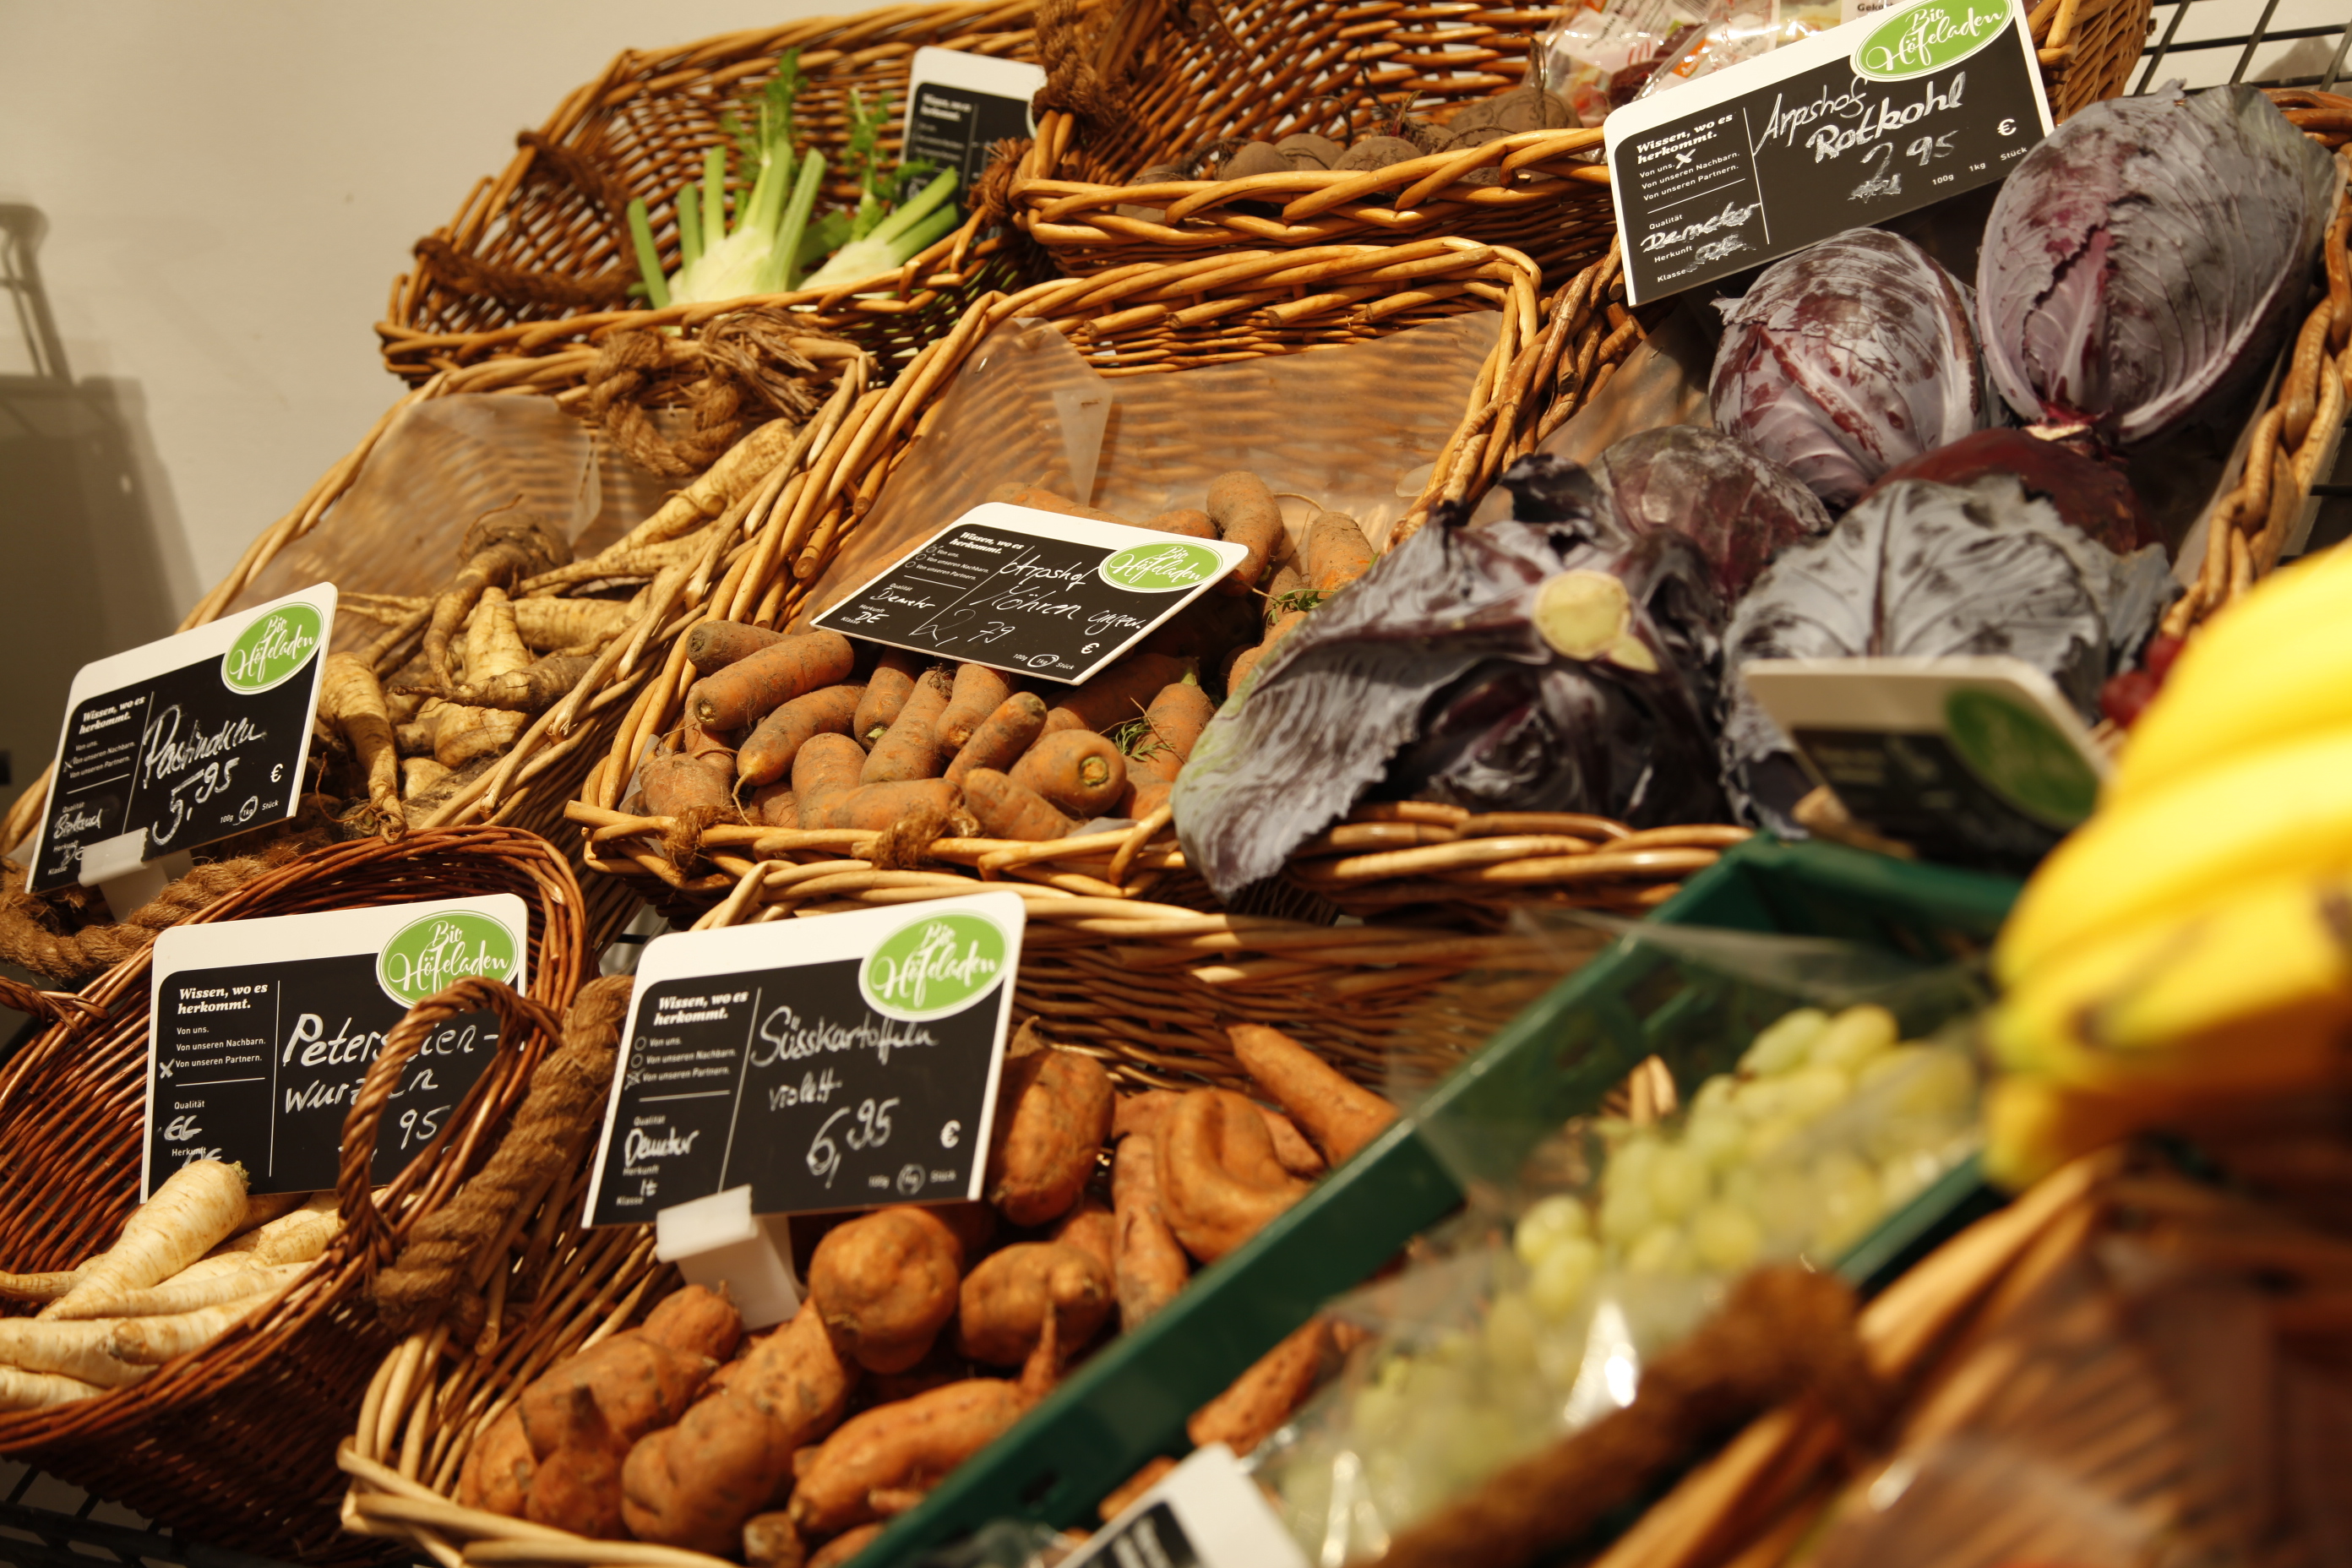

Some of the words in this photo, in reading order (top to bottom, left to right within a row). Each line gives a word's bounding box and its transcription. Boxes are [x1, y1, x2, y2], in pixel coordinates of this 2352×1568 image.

[1904, 8, 1945, 35] Bio
[1866, 7, 2003, 71] Höfeladen
[1805, 71, 1965, 163] Rotkohl
[1636, 131, 1690, 154] Wissen,
[1694, 121, 1715, 133] wo
[1718, 114, 1733, 124] es
[1997, 118, 2017, 136] €
[1637, 131, 1718, 164] herkommt.
[1639, 170, 1655, 178] Von
[1657, 163, 1675, 172] uns.
[1642, 181, 1657, 189] Von
[1659, 169, 1693, 183] unseren
[1696, 152, 1740, 171] Nachbarn.
[1932, 174, 1954, 185] 100g
[1969, 162, 1986, 172] 1kg
[2001, 147, 2028, 161] Stück
[1643, 192, 1659, 201] Von
[1661, 180, 1696, 195] unseren
[1698, 165, 1739, 182] Partnern.
[1649, 214, 1683, 230] Qualität
[1654, 245, 1692, 263] Herkunft
[1657, 269, 1686, 282] Klasse
[949, 538, 1003, 554] herkommt.
[960, 531, 994, 545] Wissen,
[1159, 546, 1189, 559] Bio
[927, 567, 950, 575] unseren
[950, 571, 977, 581] Partnern.
[937, 559, 961, 569] unseren
[961, 561, 988, 574] Nachbarn.
[1110, 554, 1204, 583] Höfeladen
[890, 583, 913, 592] Qualität
[858, 603, 885, 612] Herkunft
[264, 615, 287, 640] Bio
[841, 616, 861, 625] Klasse
[229, 624, 316, 683] Höfeladen
[1081, 642, 1100, 654] €
[1056, 662, 1075, 670] Stück
[83, 706, 117, 722] Wissen,
[119, 700, 134, 710] wo
[134, 696, 146, 705] es
[79, 711, 131, 735] herkommt.
[73, 756, 83, 765] Von
[84, 750, 106, 762] unseren
[106, 741, 135, 754] Nachbarn.
[80, 764, 104, 776] unseren
[104, 755, 131, 768] Partnern.
[270, 763, 284, 783] €
[62, 801, 85, 814] Qualität
[220, 814, 234, 824] 100g
[262, 799, 279, 811] Stück
[47, 865, 68, 875] Klasse
[428, 920, 464, 947] Bio
[918, 919, 956, 949] Bio
[388, 939, 509, 994] Höfeladen
[871, 939, 999, 1009] Höfeladen
[179, 987, 229, 1000] Wissen,
[231, 985, 252, 995] wo
[253, 984, 269, 994] es
[659, 995, 709, 1010] Wissen,
[710, 993, 732, 1005] wo
[732, 991, 749, 1004] es
[177, 999, 251, 1015] herkommt.
[653, 1006, 728, 1026] herkommt.
[176, 1043, 190, 1052] Von
[192, 1040, 224, 1050] unseren
[226, 1037, 266, 1048] Nachbarn.
[650, 1037, 663, 1048] Von
[665, 1037, 683, 1046] uns.
[191, 1057, 223, 1067] unseren
[225, 1055, 263, 1064] Partnern.
[646, 1055, 661, 1064] Von
[662, 1052, 694, 1064] unseren
[695, 1048, 737, 1060] Nachbarn.
[643, 1072, 657, 1082] Von
[658, 1070, 691, 1081] unseren
[692, 1066, 730, 1078] Partnern.
[174, 1100, 204, 1110] Qualität
[634, 1115, 666, 1127] Qualität
[940, 1119, 961, 1148] €
[172, 1146, 206, 1157] Herkunft
[806, 1097, 900, 1189] 6,95
